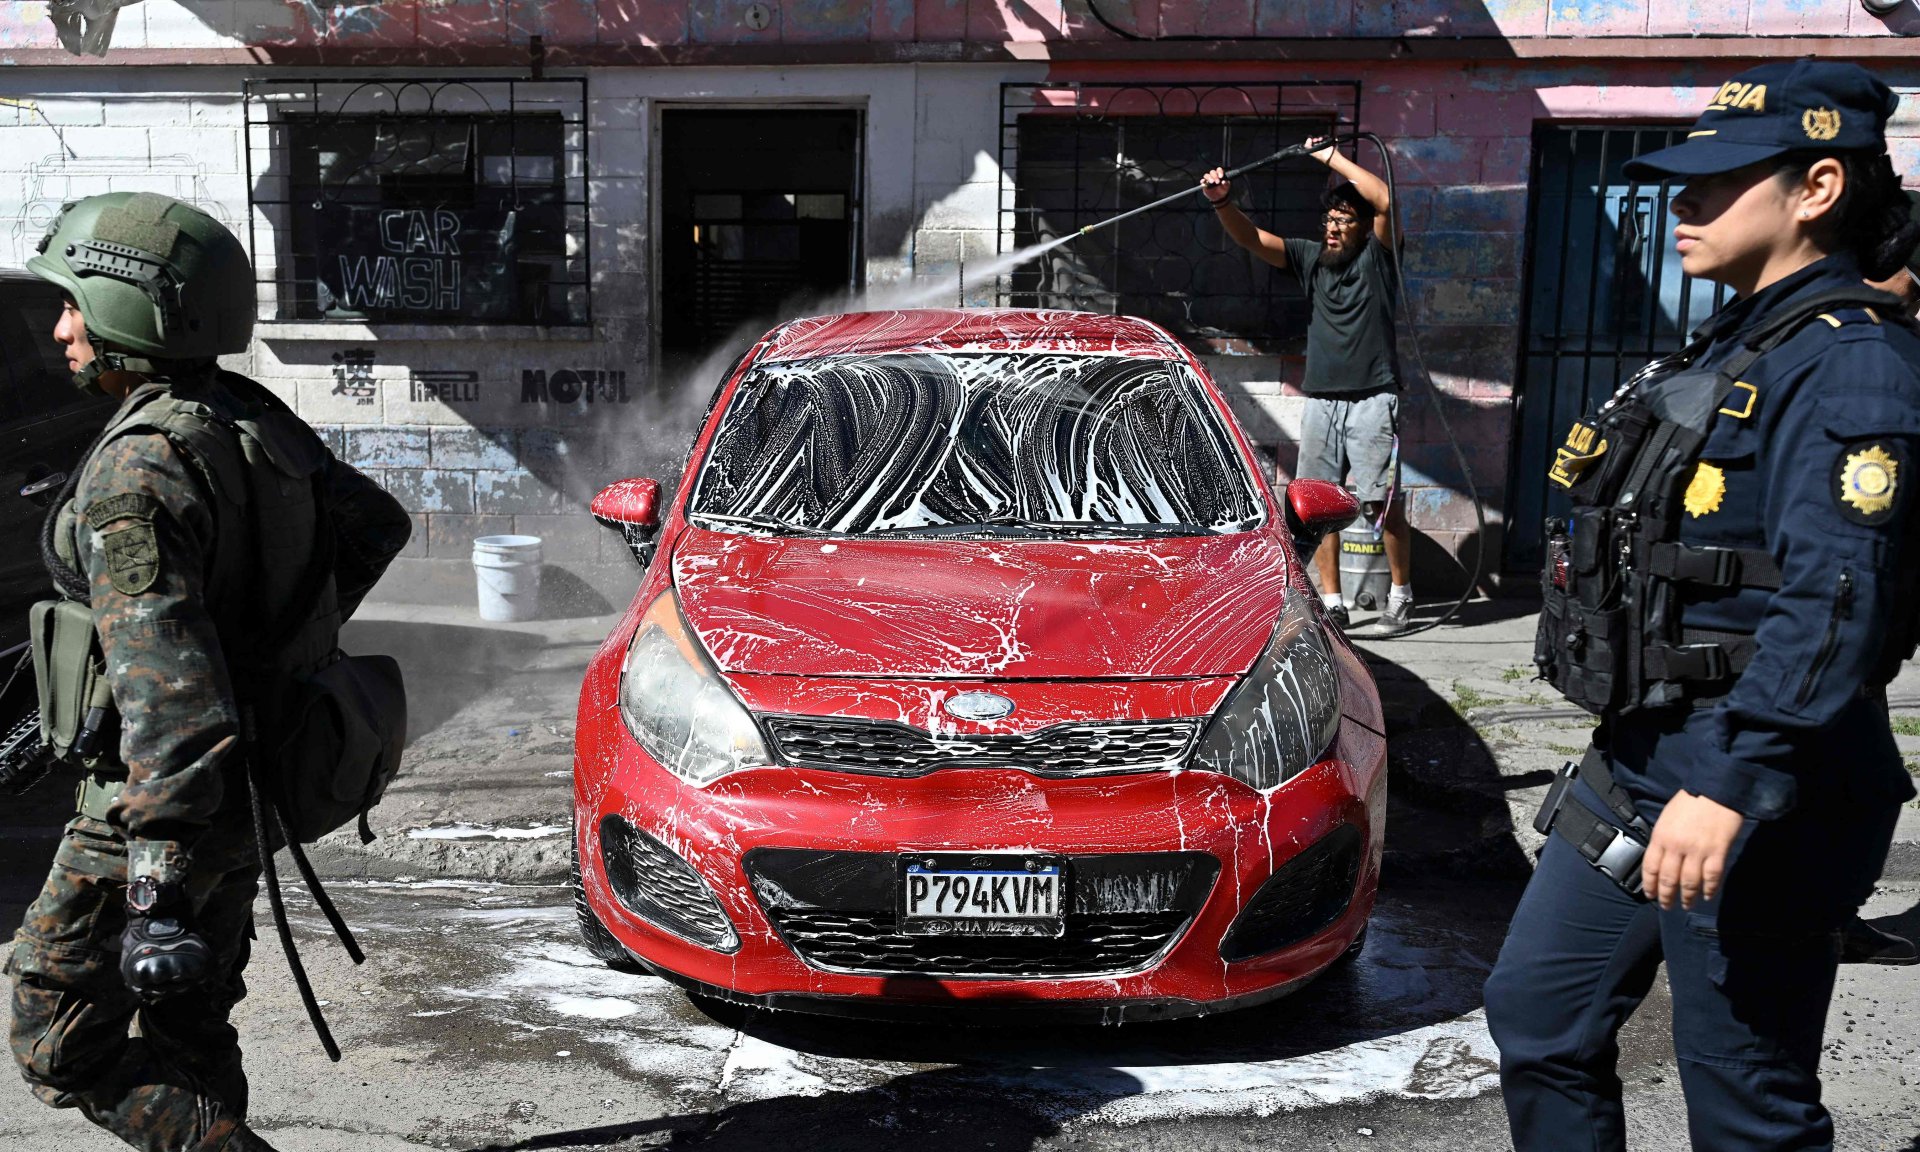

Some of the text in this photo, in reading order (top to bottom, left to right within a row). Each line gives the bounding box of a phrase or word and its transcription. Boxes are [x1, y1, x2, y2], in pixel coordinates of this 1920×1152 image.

[1711, 80, 1767, 112] ICIA
[378, 209, 461, 255] CAR
[339, 254, 461, 310] WASH
[409, 370, 480, 403] PIRELLI
[521, 369, 631, 404] MOTUL
[1343, 542, 1384, 554] STANLE
[909, 875, 1053, 914] P794KVM
[953, 920, 981, 933] KIA
